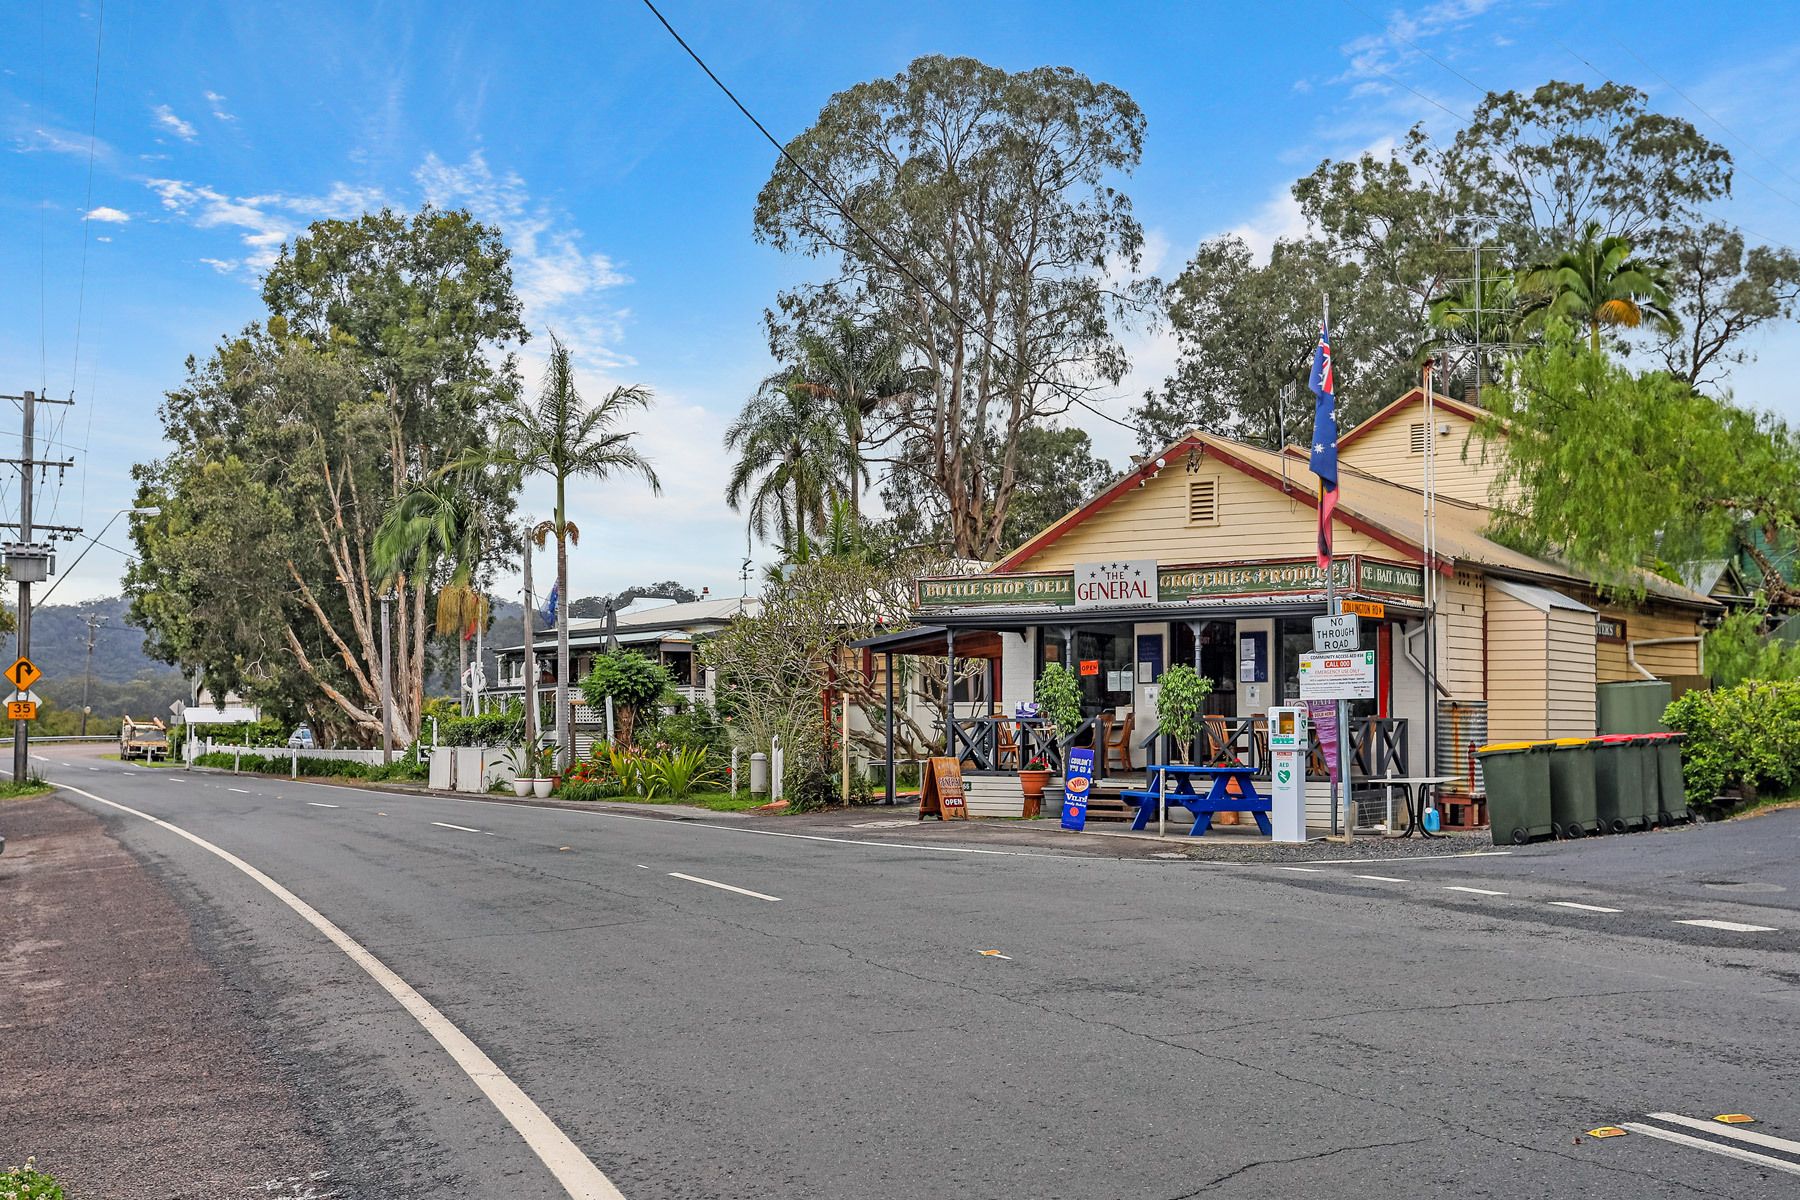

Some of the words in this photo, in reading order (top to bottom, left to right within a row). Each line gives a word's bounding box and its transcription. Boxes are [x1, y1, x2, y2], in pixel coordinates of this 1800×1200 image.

[1105, 571, 1125, 580] THE
[1159, 570, 1251, 588] GROCERIES
[1259, 564, 1341, 583] PRODUCE
[1361, 566, 1372, 580] ICE
[1377, 568, 1392, 583] BAIT
[1396, 571, 1421, 587] TACKLE
[926, 582, 980, 597] BOTTLE
[983, 581, 1025, 595] SHOP
[1034, 579, 1071, 593] DELI
[1077, 579, 1152, 601] GENERAL
[1330, 617, 1344, 627] NO
[1316, 627, 1355, 639] THROUGH
[1324, 639, 1349, 650] ROAD
[14, 704, 30, 713] 35
